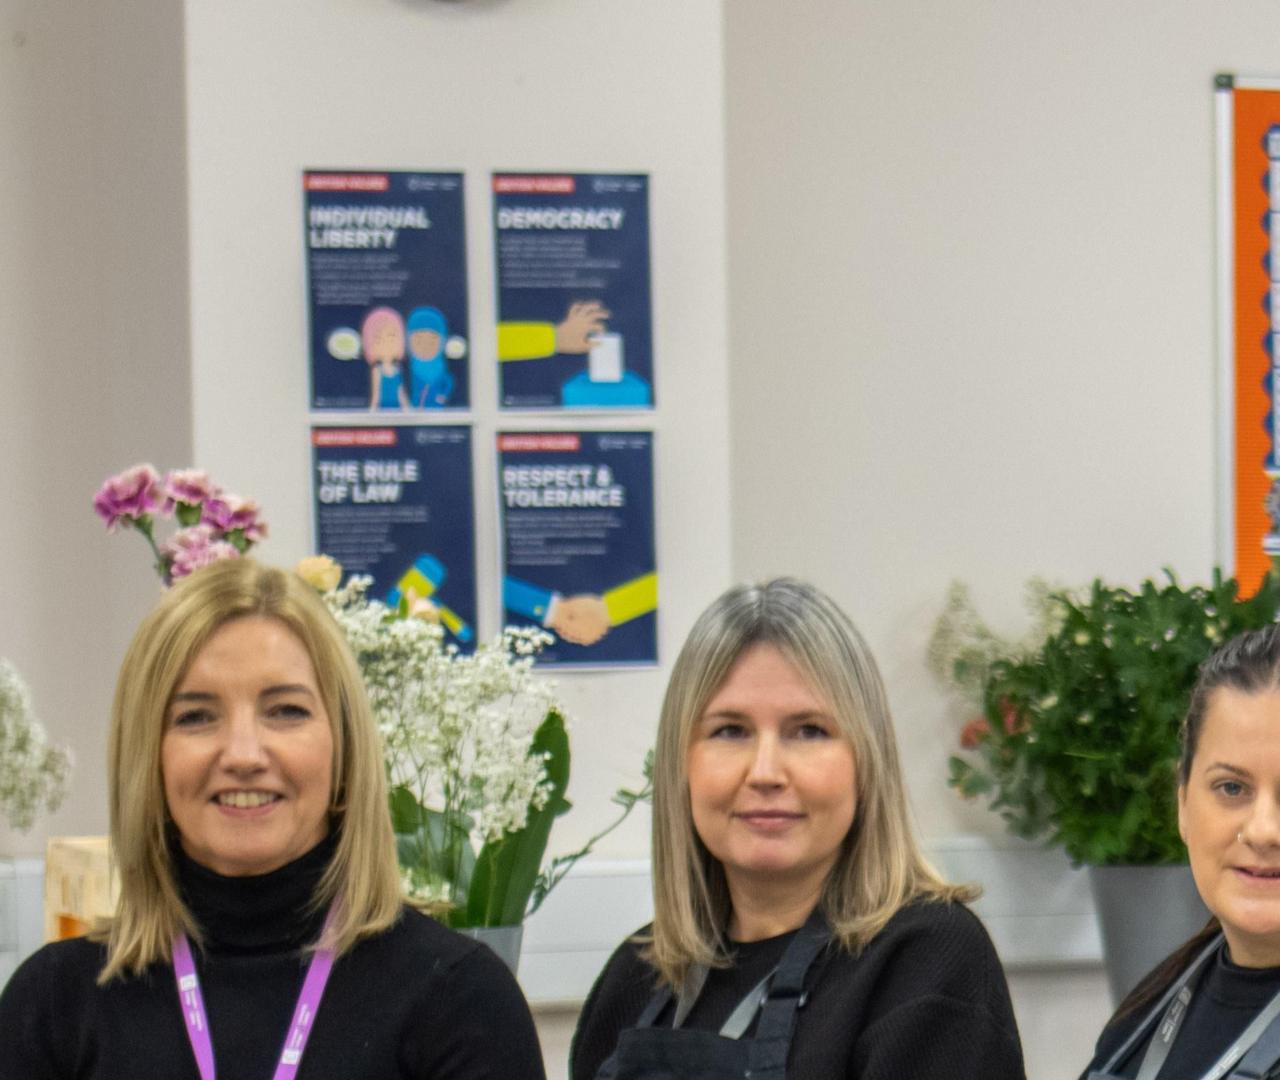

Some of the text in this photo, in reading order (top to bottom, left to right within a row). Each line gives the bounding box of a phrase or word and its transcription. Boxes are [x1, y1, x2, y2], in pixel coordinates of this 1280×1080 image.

[310, 207, 430, 229] INDIVIDUAL
[498, 208, 623, 230] DEMOCRACY
[310, 229, 396, 248] LIBERTY
[319, 460, 419, 482] THE RULE
[504, 464, 612, 487] RESPECT &
[319, 483, 400, 503] OF LAW
[504, 486, 624, 507] TOLERANCE
